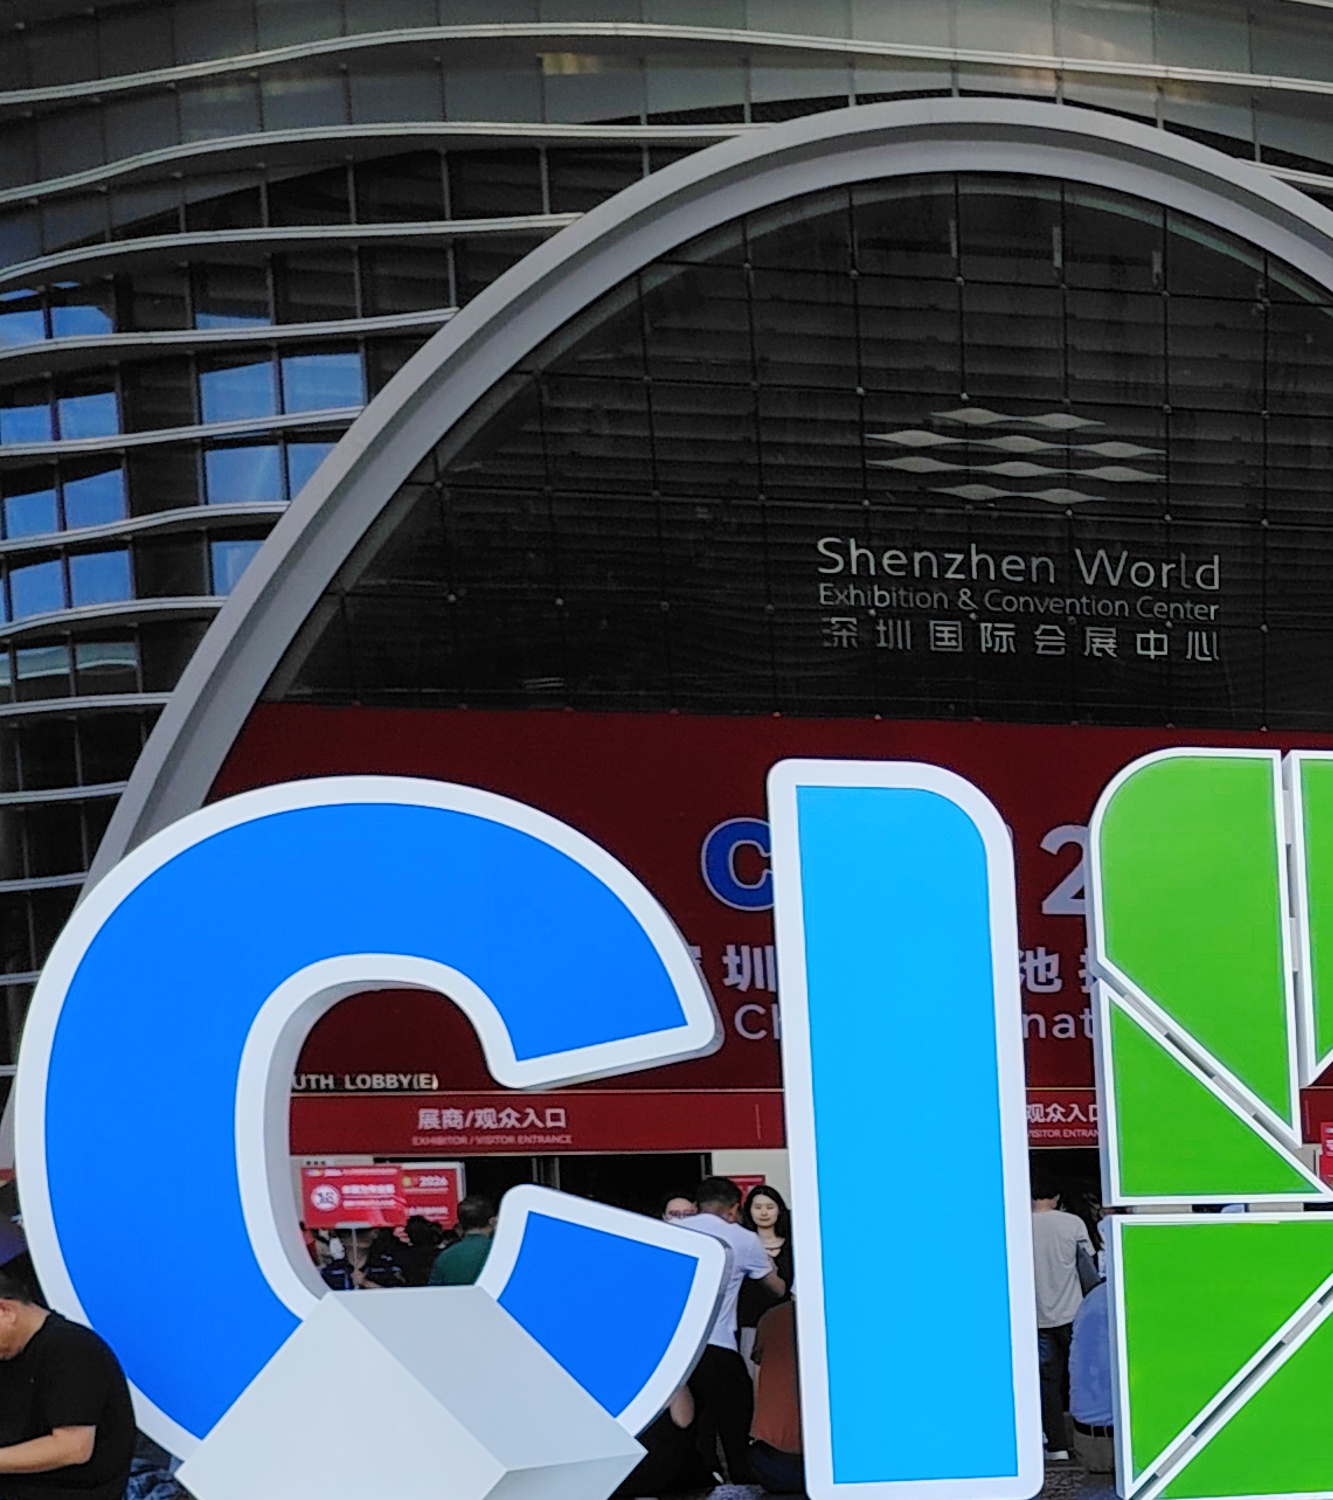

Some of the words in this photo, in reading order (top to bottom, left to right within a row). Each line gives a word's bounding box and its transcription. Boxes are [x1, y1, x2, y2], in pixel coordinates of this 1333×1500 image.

[816, 536, 1056, 584] Shenzhen
[1074, 547, 1221, 591] World
[819, 582, 949, 609] Exhibition
[956, 585, 978, 610] &
[984, 588, 1130, 618] Convention
[1136, 597, 1220, 622] Center
[822, 616, 1220, 662] 深圳国际会展中心
[418, 1107, 567, 1130] 展商/观众入口
[1026, 1103, 1098, 1123] 观众入口
